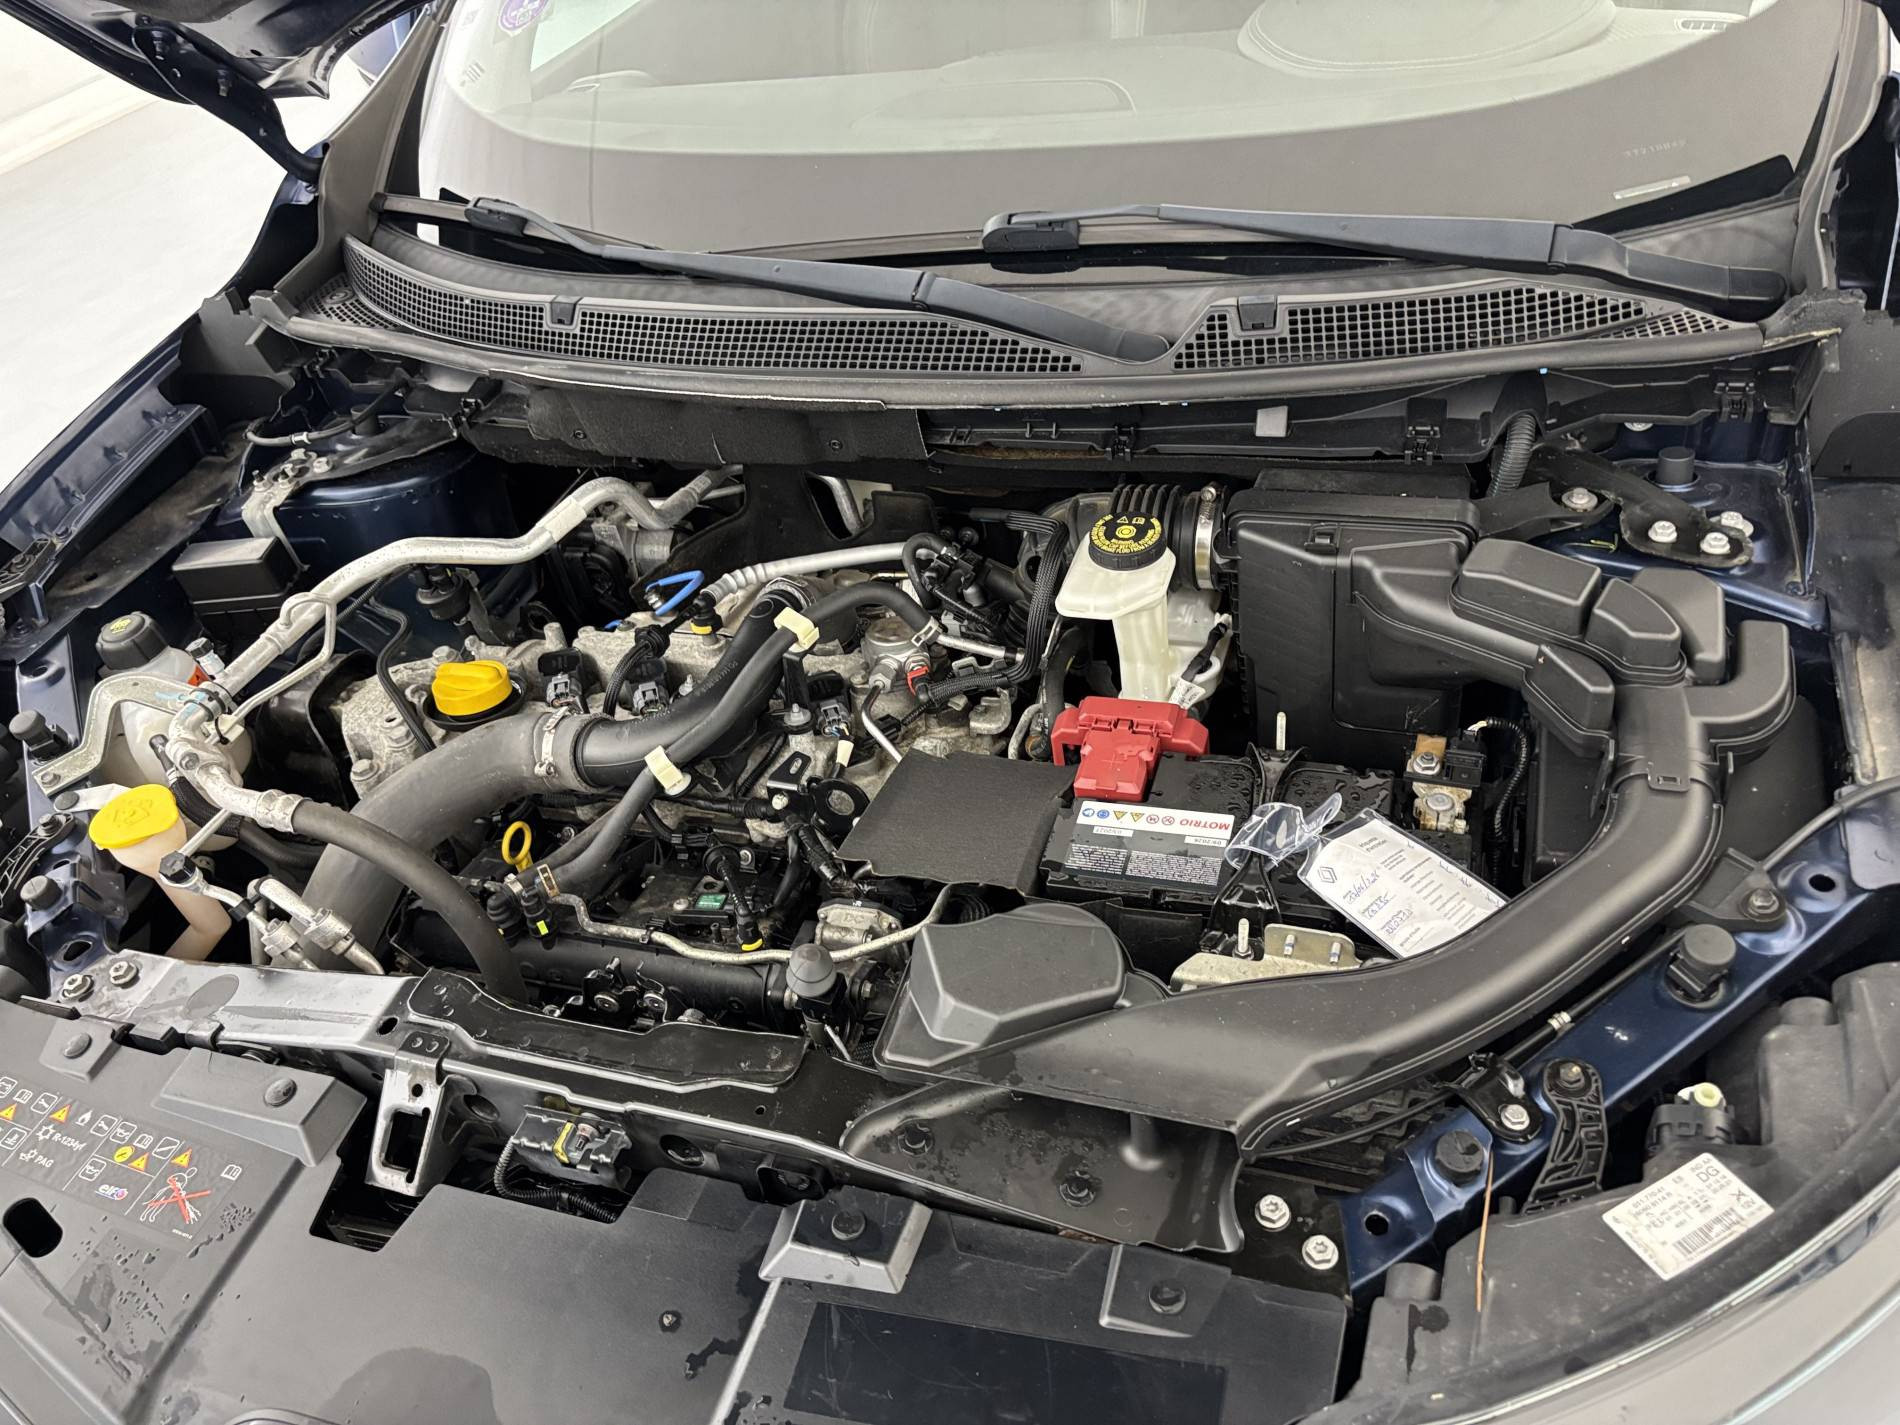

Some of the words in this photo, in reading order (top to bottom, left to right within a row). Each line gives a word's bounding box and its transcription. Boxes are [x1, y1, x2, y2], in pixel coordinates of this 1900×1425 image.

[1179, 818, 1231, 831] MOTRIO
[51, 1131, 87, 1151] R-1234yf
[34, 1151, 55, 1169] PAG
[1695, 1165, 1720, 1183] DG
[98, 1182, 119, 1199] elf
